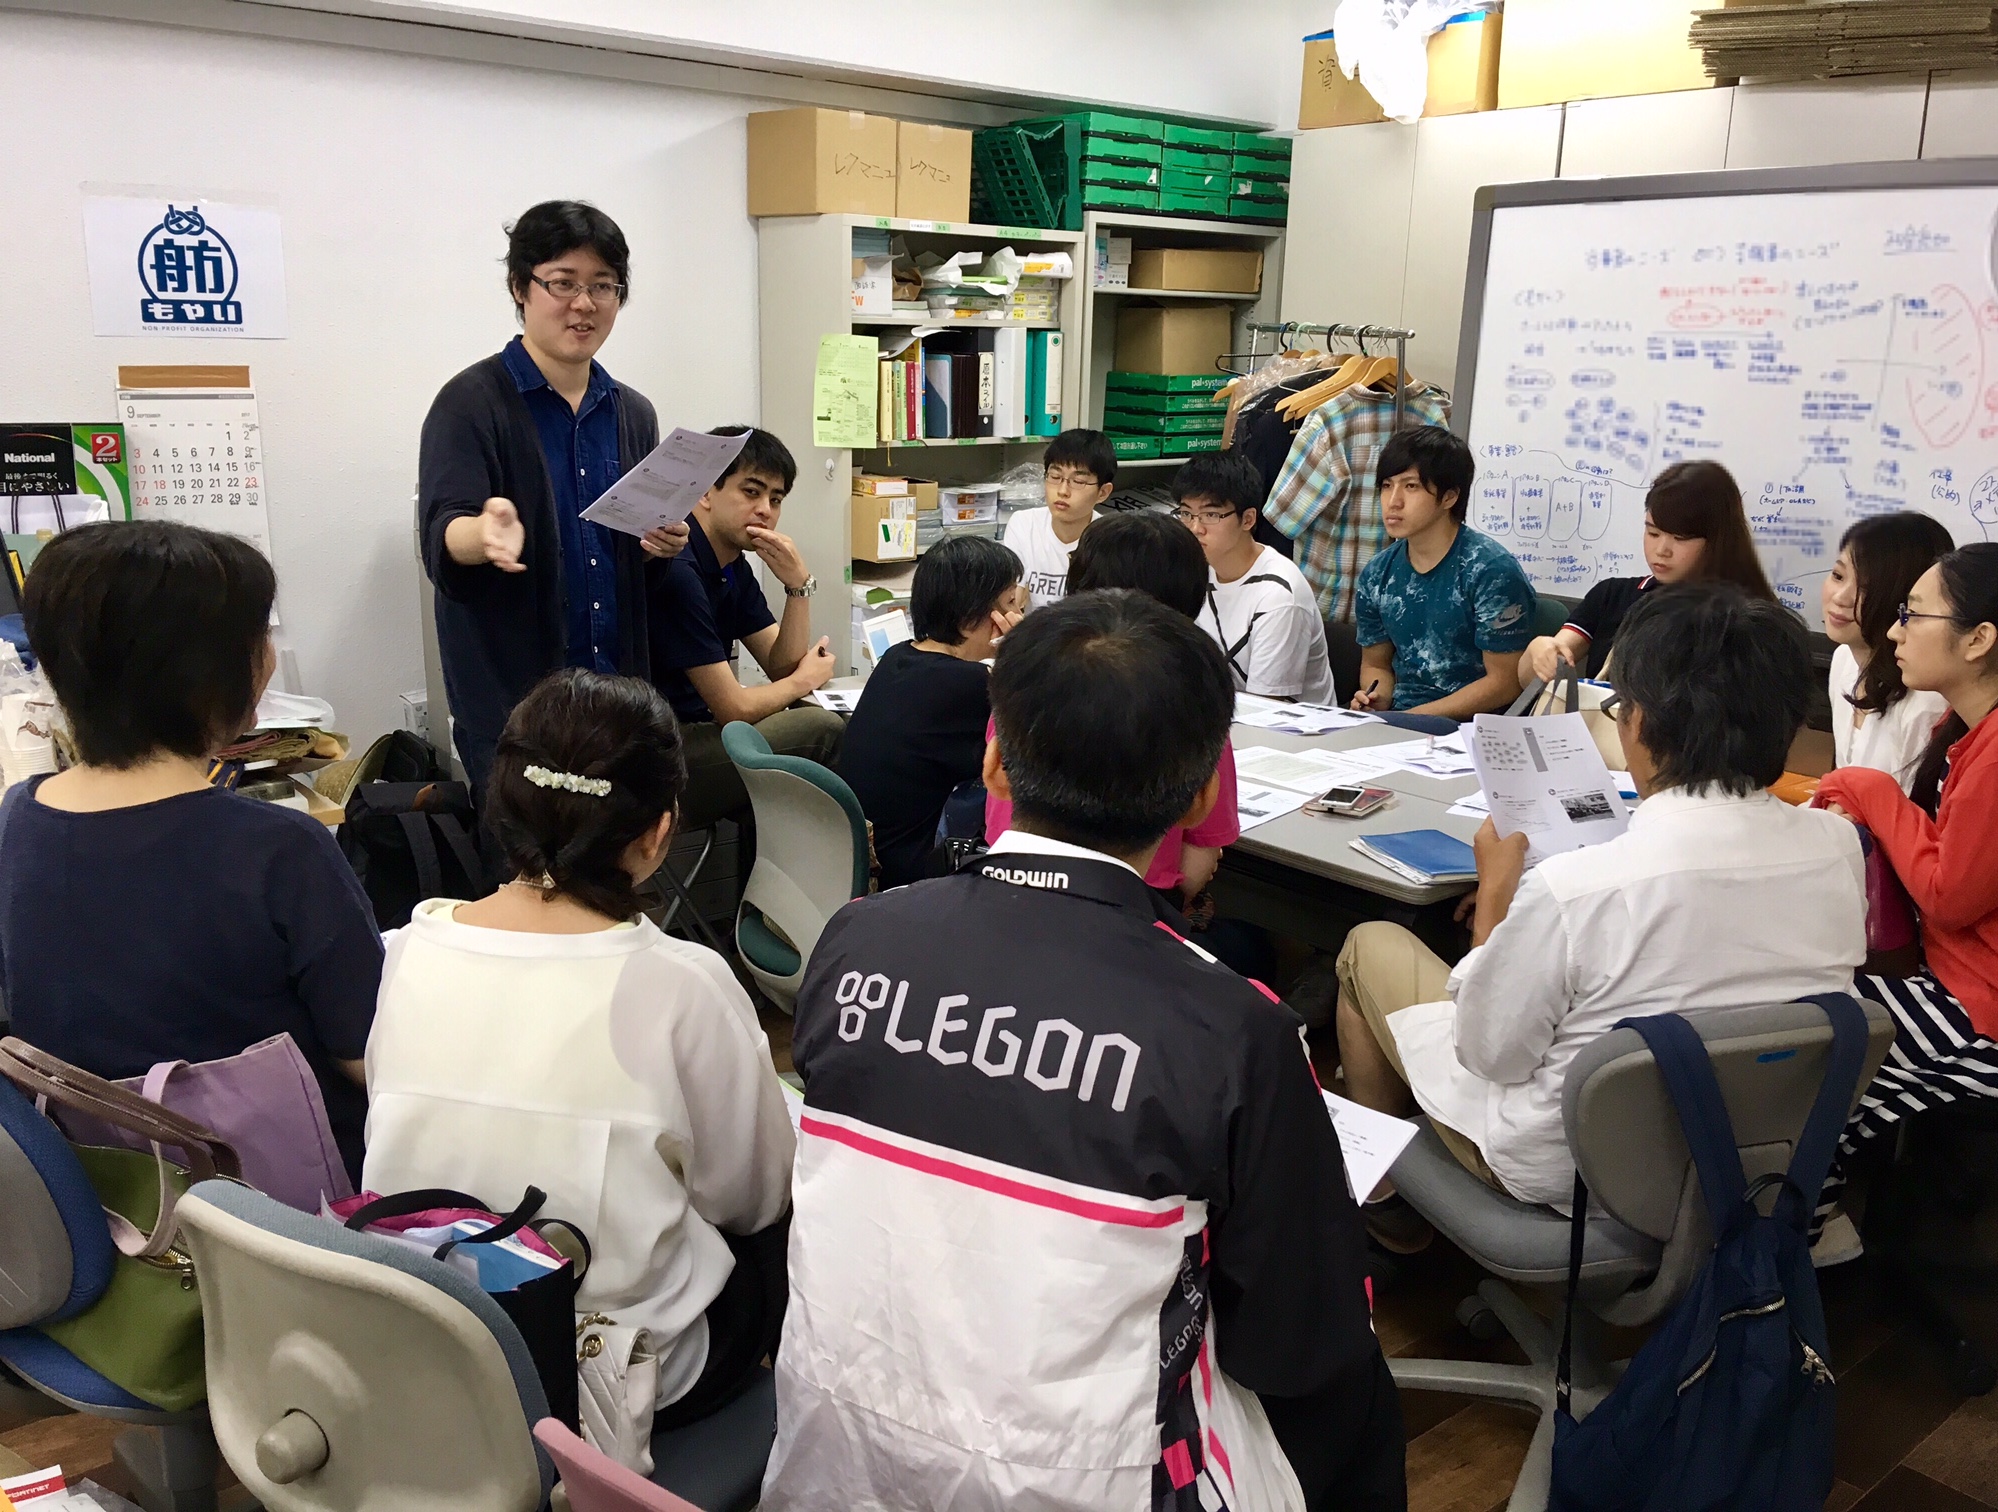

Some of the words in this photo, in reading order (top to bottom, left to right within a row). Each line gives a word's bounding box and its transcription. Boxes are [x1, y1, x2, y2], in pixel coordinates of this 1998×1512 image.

[148, 303, 236, 321] もやい
[127, 405, 135, 418] 9
[226, 431, 231, 440] 1
[244, 431, 249, 440] 2
[95, 435, 117, 457] 2
[134, 449, 140, 458] 3
[153, 449, 160, 457] 4
[172, 448, 178, 457] 5
[191, 448, 197, 457] 6
[209, 447, 215, 456] 7
[227, 447, 233, 456] 8
[245, 446, 251, 456] 9
[4, 452, 56, 463] National
[134, 465, 146, 474] 10
[152, 464, 163, 473] 11
[171, 464, 183, 473] 12
[190, 464, 202, 473] 13
[208, 463, 220, 472] 14
[226, 462, 238, 471] 15
[244, 462, 255, 471] 16
[135, 481, 146, 490] 17
[154, 480, 166, 489] 18
[173, 480, 185, 489] 19
[191, 479, 203, 488] 20
[209, 479, 220, 488] 21
[227, 478, 239, 487] 22
[245, 477, 257, 486] 23
[136, 497, 148, 506] 24
[155, 496, 167, 505] 25
[174, 496, 186, 505] 26
[192, 495, 204, 504] 27
[211, 494, 223, 503] 28
[229, 493, 241, 502] 29
[247, 492, 258, 501] 30
[981, 865, 1069, 889] GOLDWIN
[884, 980, 1142, 1112] LEGON
